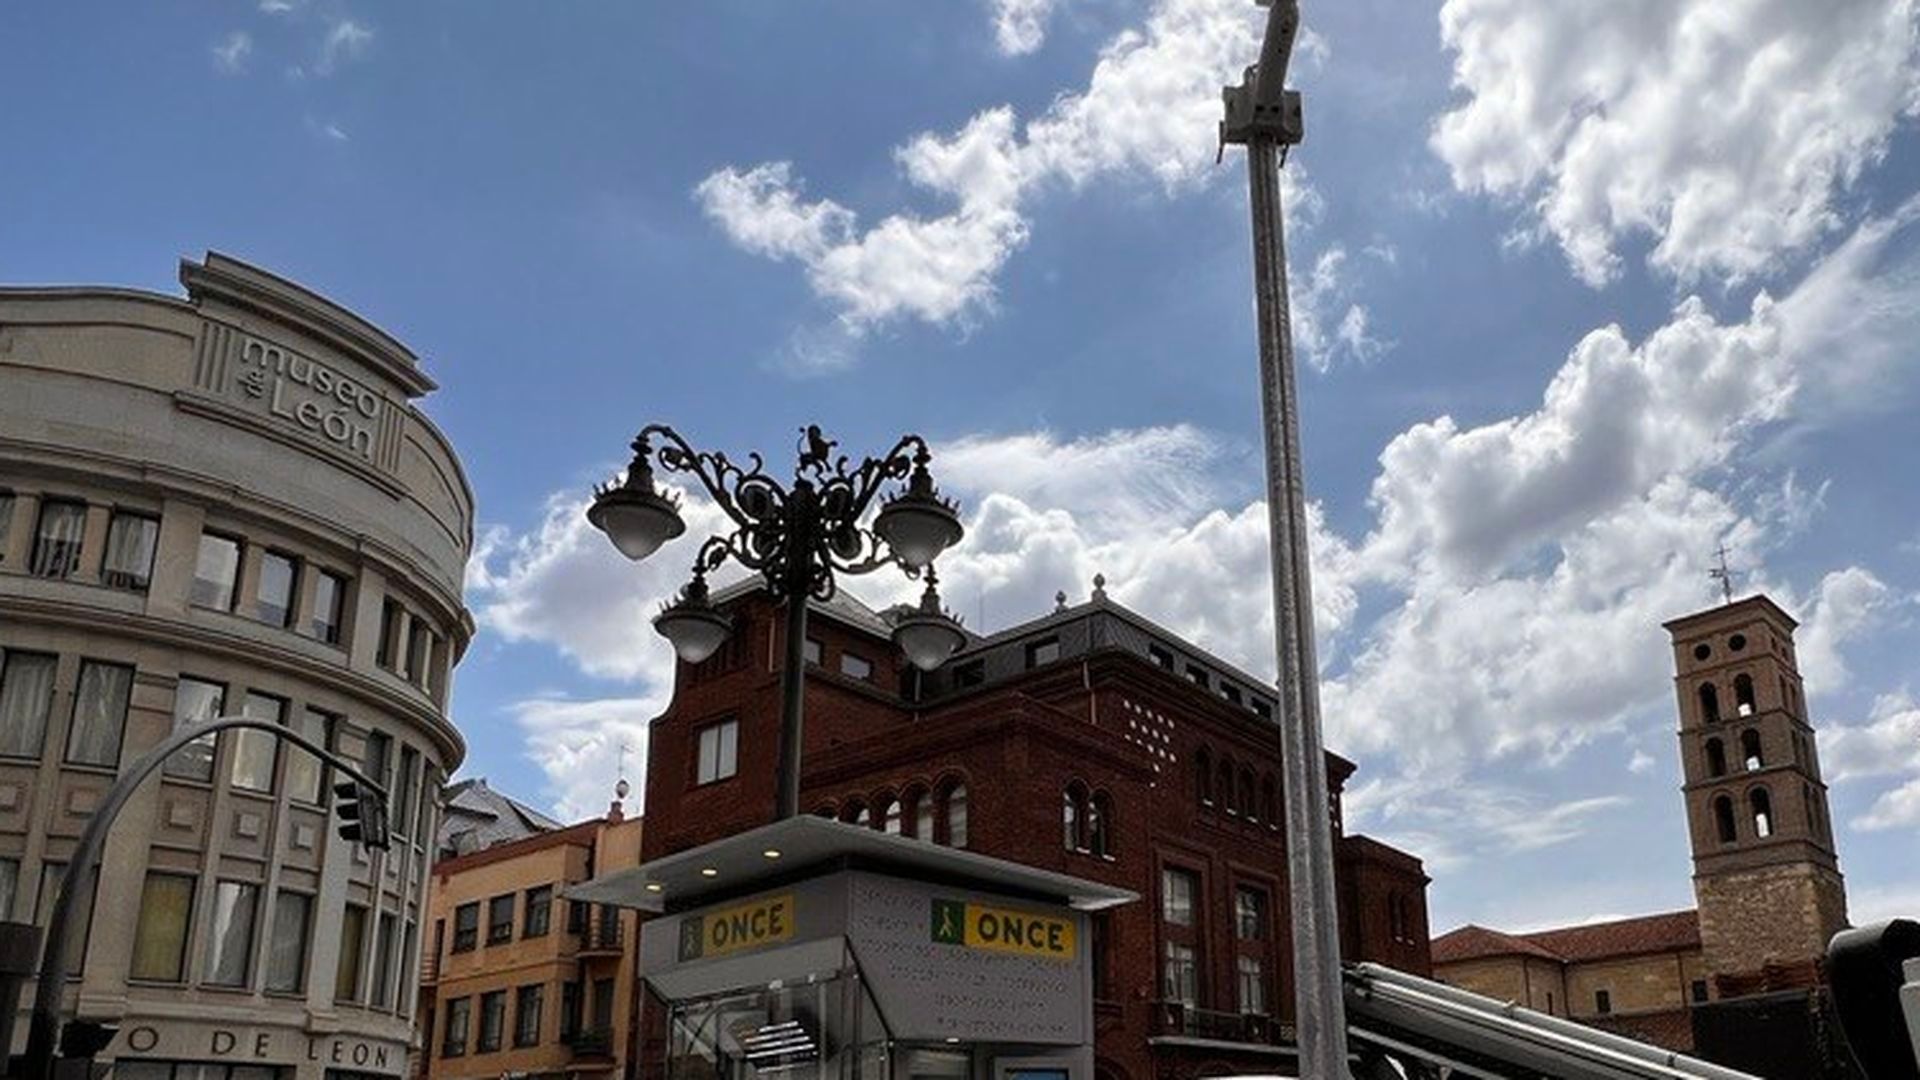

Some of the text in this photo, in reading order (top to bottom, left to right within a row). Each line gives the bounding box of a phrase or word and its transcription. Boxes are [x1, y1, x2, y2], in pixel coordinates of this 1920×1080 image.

[242, 336, 382, 420] museo
[271, 378, 375, 459] León
[712, 903, 783, 947] ONCE
[978, 913, 1065, 952] ONCE
[211, 1030, 271, 1058] DE
[307, 1038, 388, 1068] LEON
